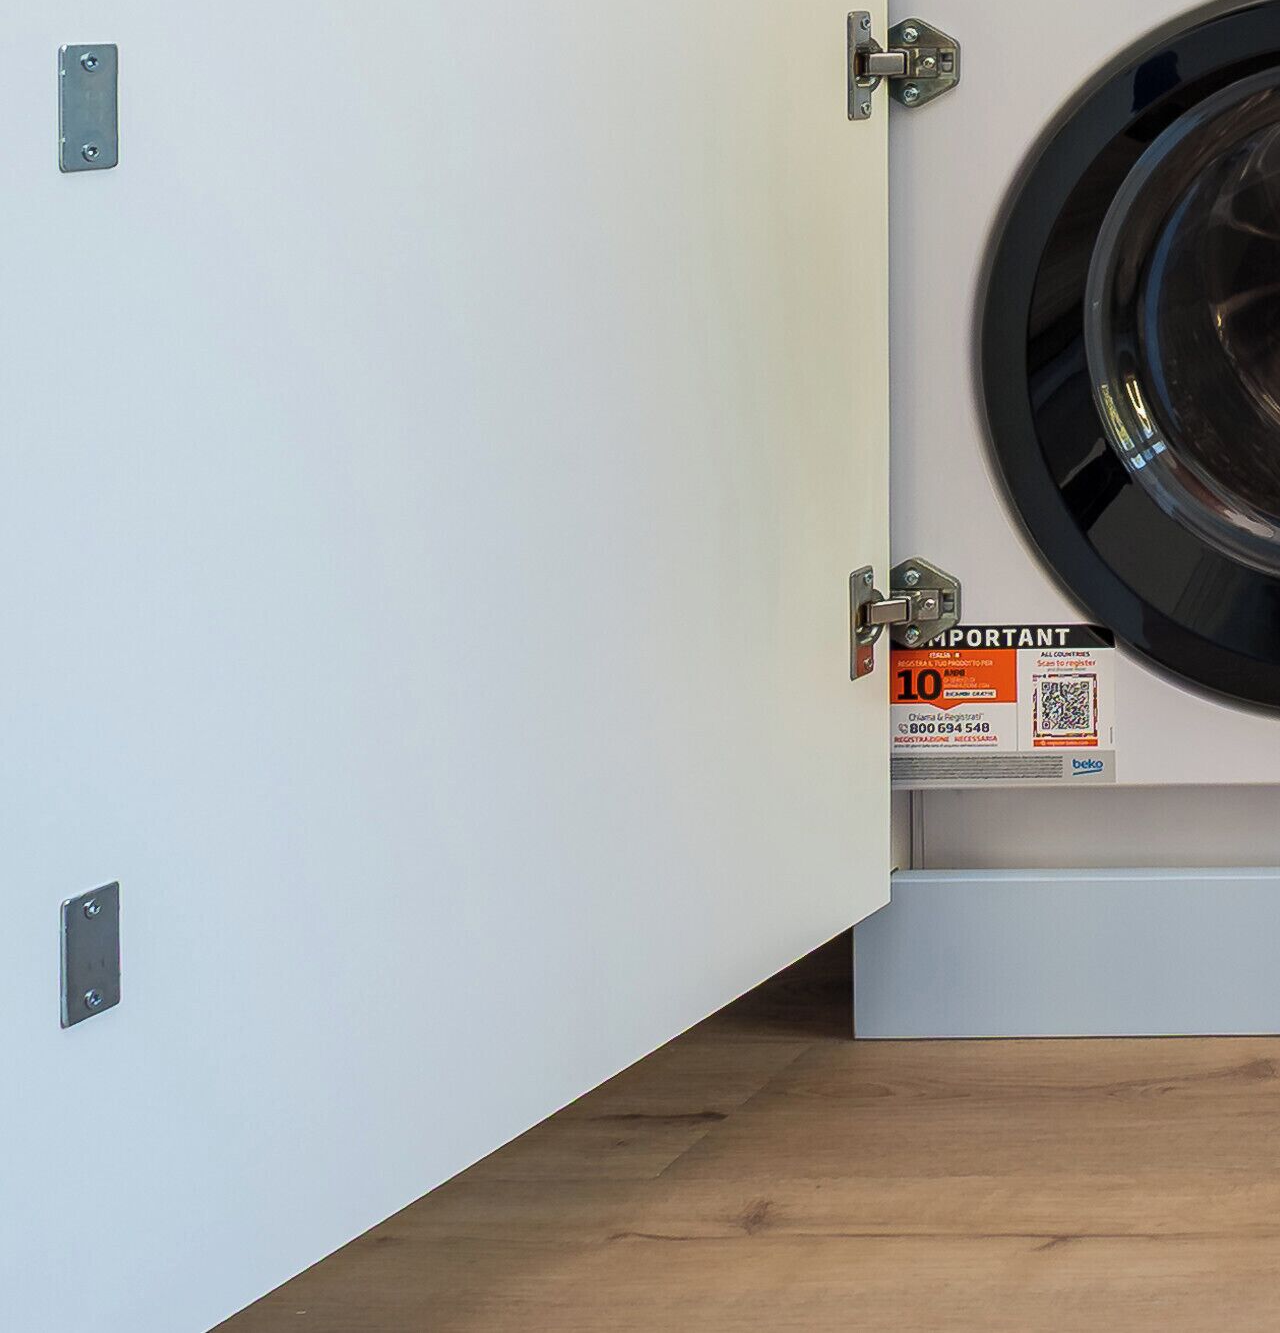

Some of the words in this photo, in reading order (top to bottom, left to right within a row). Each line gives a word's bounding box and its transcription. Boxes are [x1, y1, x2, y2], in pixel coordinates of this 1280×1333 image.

[921, 627, 1070, 647] MPORTANT
[898, 668, 943, 701] 10
[909, 723, 935, 734] 800
[938, 723, 963, 733] 694
[965, 722, 990, 733] 548
[1072, 759, 1104, 769] beko
